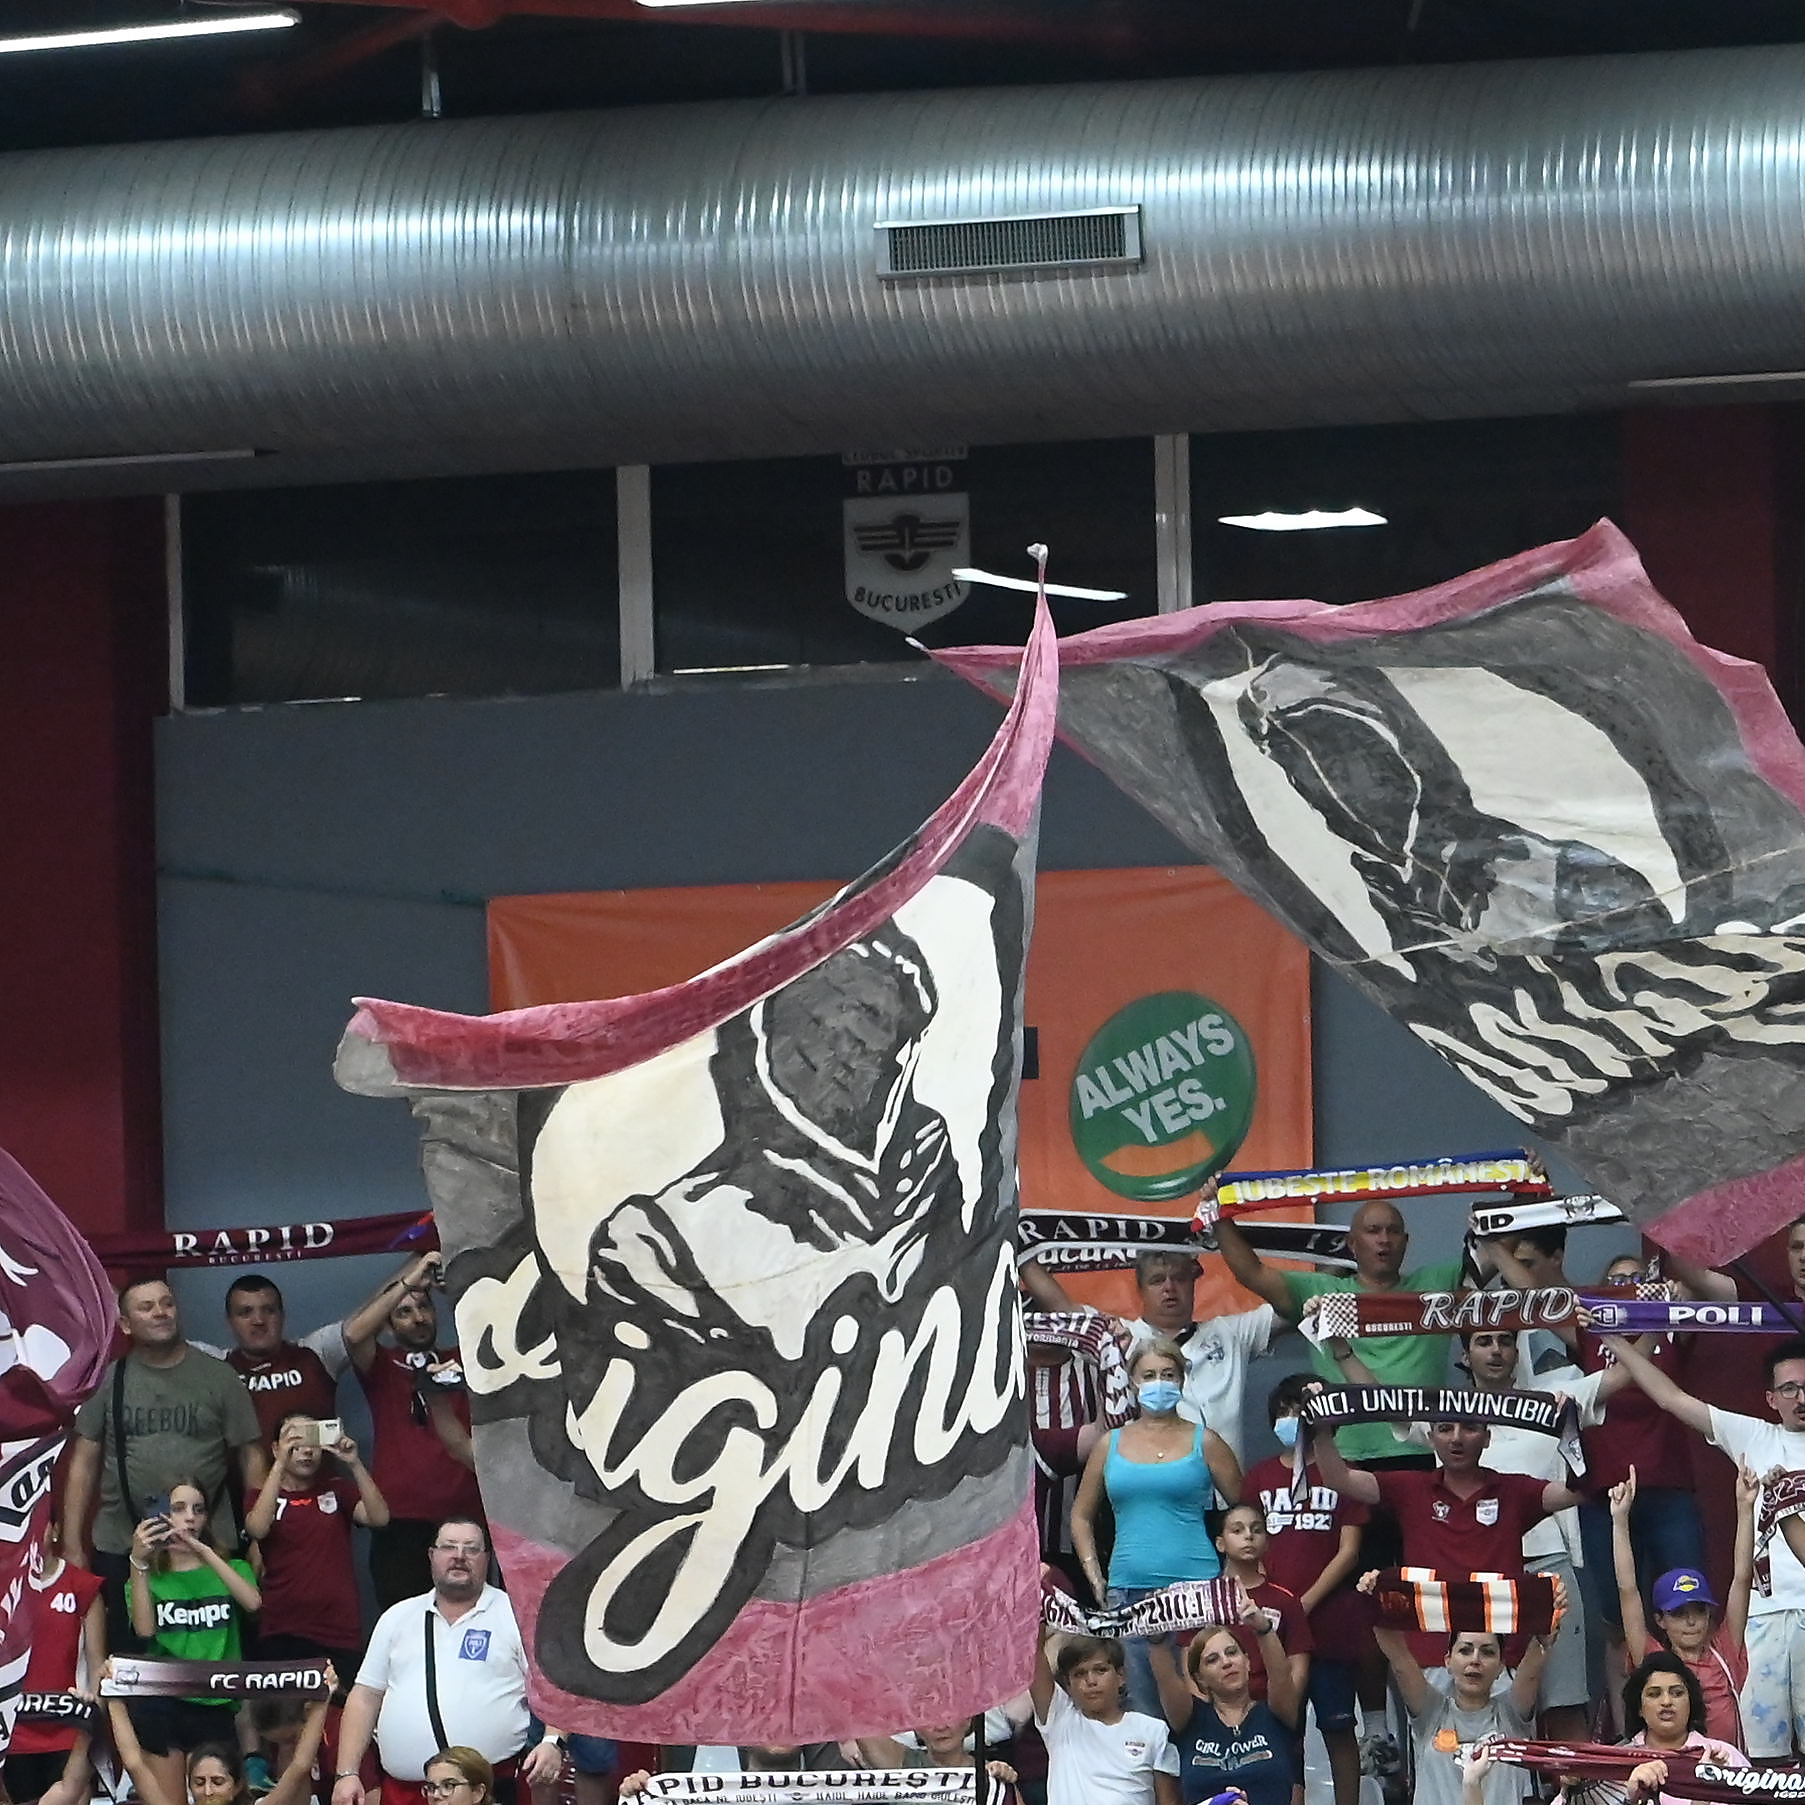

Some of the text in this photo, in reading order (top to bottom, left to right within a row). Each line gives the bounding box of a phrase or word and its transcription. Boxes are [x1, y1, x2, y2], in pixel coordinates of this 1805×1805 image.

[856, 465, 954, 493] RAPID
[854, 582, 962, 613] BUCURESTI
[1073, 1008, 1237, 1124] ALWAYS
[1119, 1075, 1228, 1146] YES.
[171, 1221, 336, 1257] RAPID
[1019, 1218, 1347, 1253] RAPID 19
[1419, 1288, 1576, 1331] RAPID
[1668, 1305, 1763, 1327] POLI
[1259, 1486, 1338, 1512] RAID
[50, 1592, 77, 1614] 40
[209, 1668, 322, 1690] FC RAPID
[1195, 1739, 1222, 1755] GIRL
